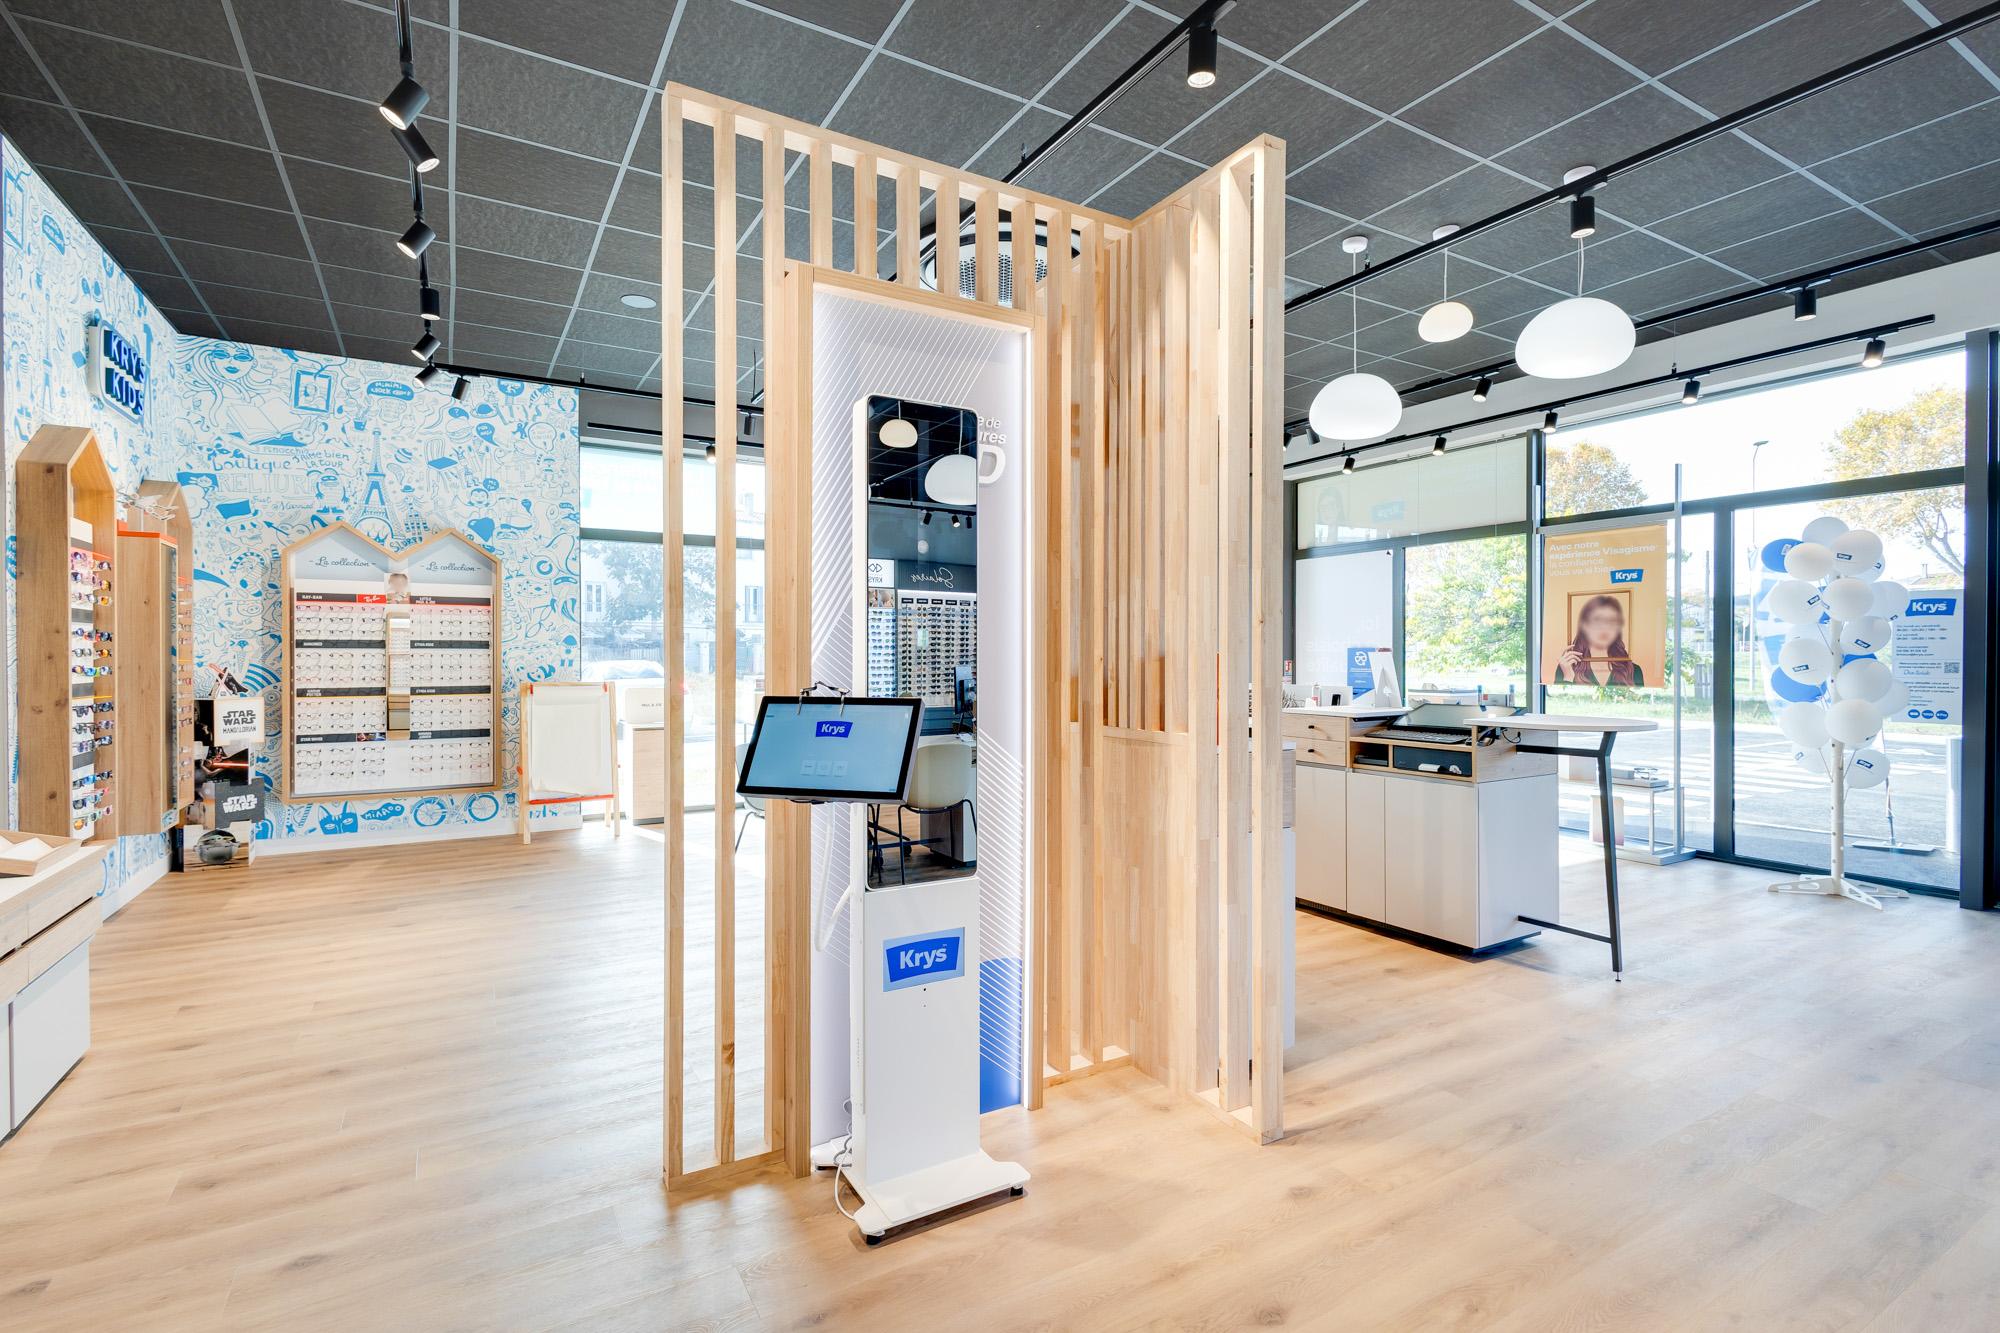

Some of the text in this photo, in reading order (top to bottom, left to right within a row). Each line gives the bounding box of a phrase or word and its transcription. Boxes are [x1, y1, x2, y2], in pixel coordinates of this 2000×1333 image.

[105, 331, 146, 383] KRYS
[108, 369, 145, 415] KIDS
[986, 416, 1001, 428] de
[979, 444, 1006, 484] D
[1550, 541, 1600, 551] Avec notre
[315, 556, 369, 568] La collection
[425, 561, 476, 572] La collection
[1615, 571, 1638, 581] Krys
[1911, 601, 1948, 614] Krys
[222, 709, 256, 719] STAR
[223, 717, 256, 726] WARS
[821, 723, 846, 735] Krys
[226, 794, 258, 804] STAR
[223, 801, 258, 814] WARS
[899, 947, 948, 970] Krys
